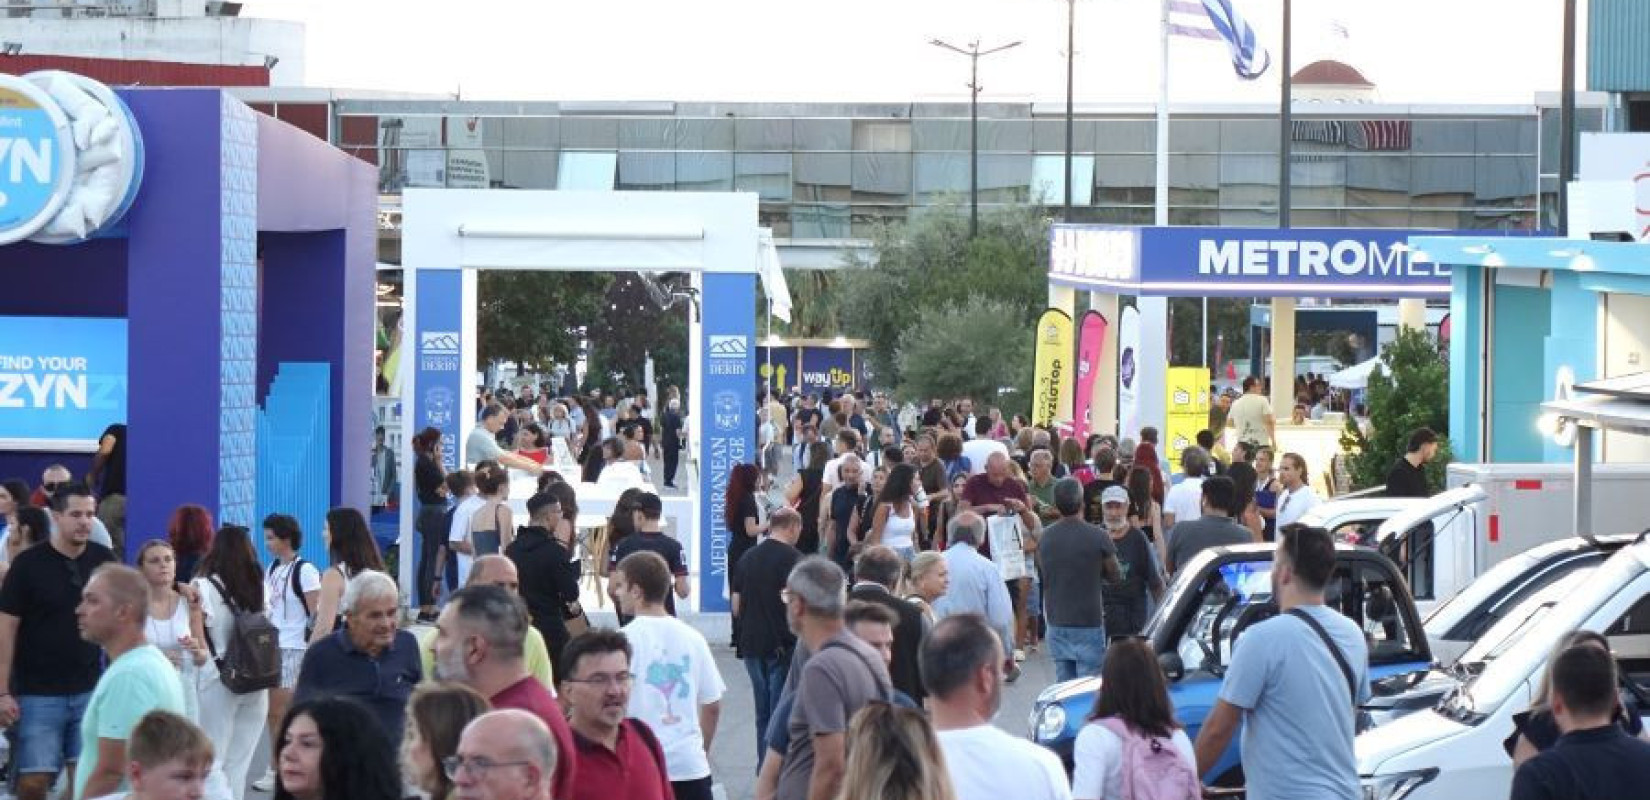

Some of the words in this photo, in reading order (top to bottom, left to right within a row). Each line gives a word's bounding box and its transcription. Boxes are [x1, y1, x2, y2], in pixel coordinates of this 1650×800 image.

[37, 356, 87, 371] YOUR
[0, 373, 87, 410] ZYN
[711, 437, 727, 576] MEDITERRANEAN
